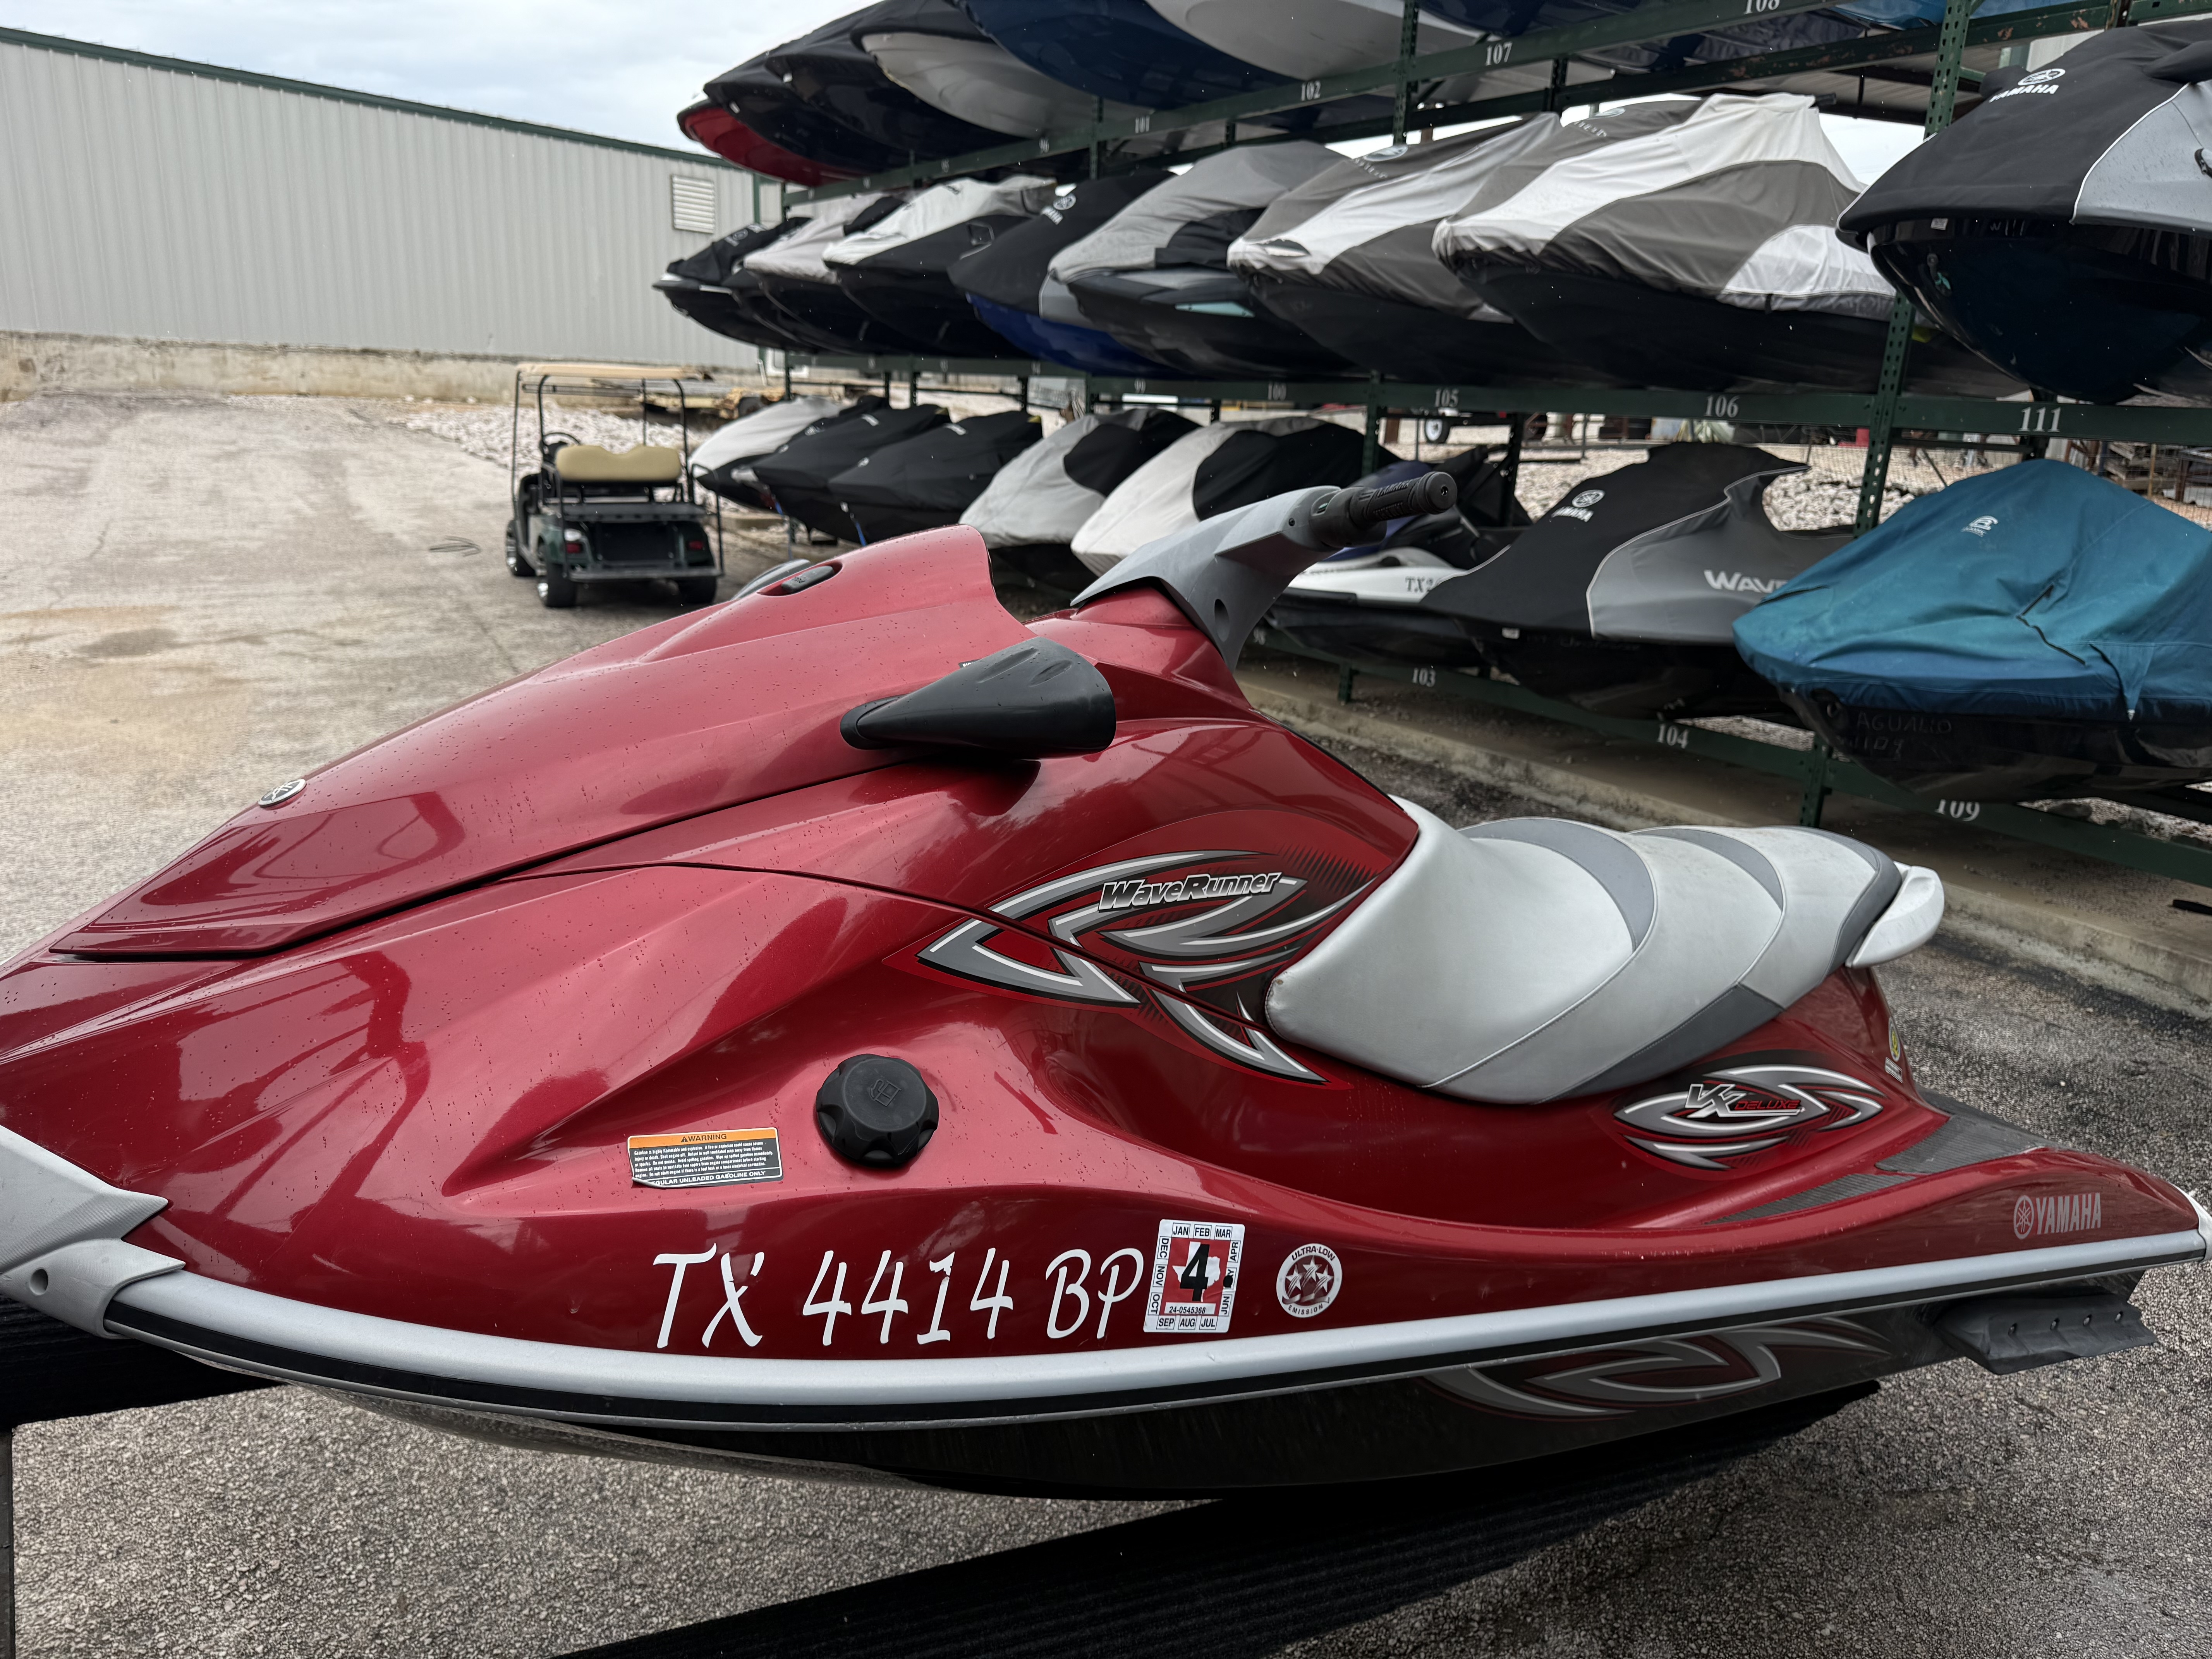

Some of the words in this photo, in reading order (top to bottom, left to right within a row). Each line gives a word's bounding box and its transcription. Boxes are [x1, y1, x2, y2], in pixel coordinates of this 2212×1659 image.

[1744, 0, 1779, 14] 108
[1486, 41, 1512, 66] 107
[1301, 82, 1321, 101] 102
[1989, 84, 2059, 103] YAMAHA
[1135, 116, 1150, 134] 101
[1434, 388, 1459, 408] 105
[1705, 395, 1740, 418] 106
[2019, 407, 2061, 433] 111
[1412, 667, 1435, 687] 103
[1657, 724, 1690, 749] 104
[1935, 799, 1980, 821] 109
[1098, 872, 1282, 910] WaveRunner
[688, 1134, 727, 1142] WARNING
[2036, 1192, 2101, 1235] YAMAHA
[1173, 1226, 1189, 1235] JAN
[1194, 1227, 1210, 1237] FEB
[1216, 1229, 1231, 1238] MAR
[1160, 1238, 1169, 1258] DEC
[1230, 1242, 1238, 1262] APR
[1156, 1266, 1165, 1286] NOV
[1180, 1244, 1210, 1302] 4
[653, 1243, 764, 1348] TX
[802, 1247, 1013, 1346] 4414
[1046, 1248, 1144, 1340] BP
[1151, 1294, 1160, 1314] OCT
[1221, 1296, 1230, 1315] JUN
[1288, 1303, 1323, 1315] EMISSION
[1158, 1318, 1174, 1327] SEP
[1180, 1318, 1195, 1327] AUG
[1201, 1318, 1215, 1327] JUL
